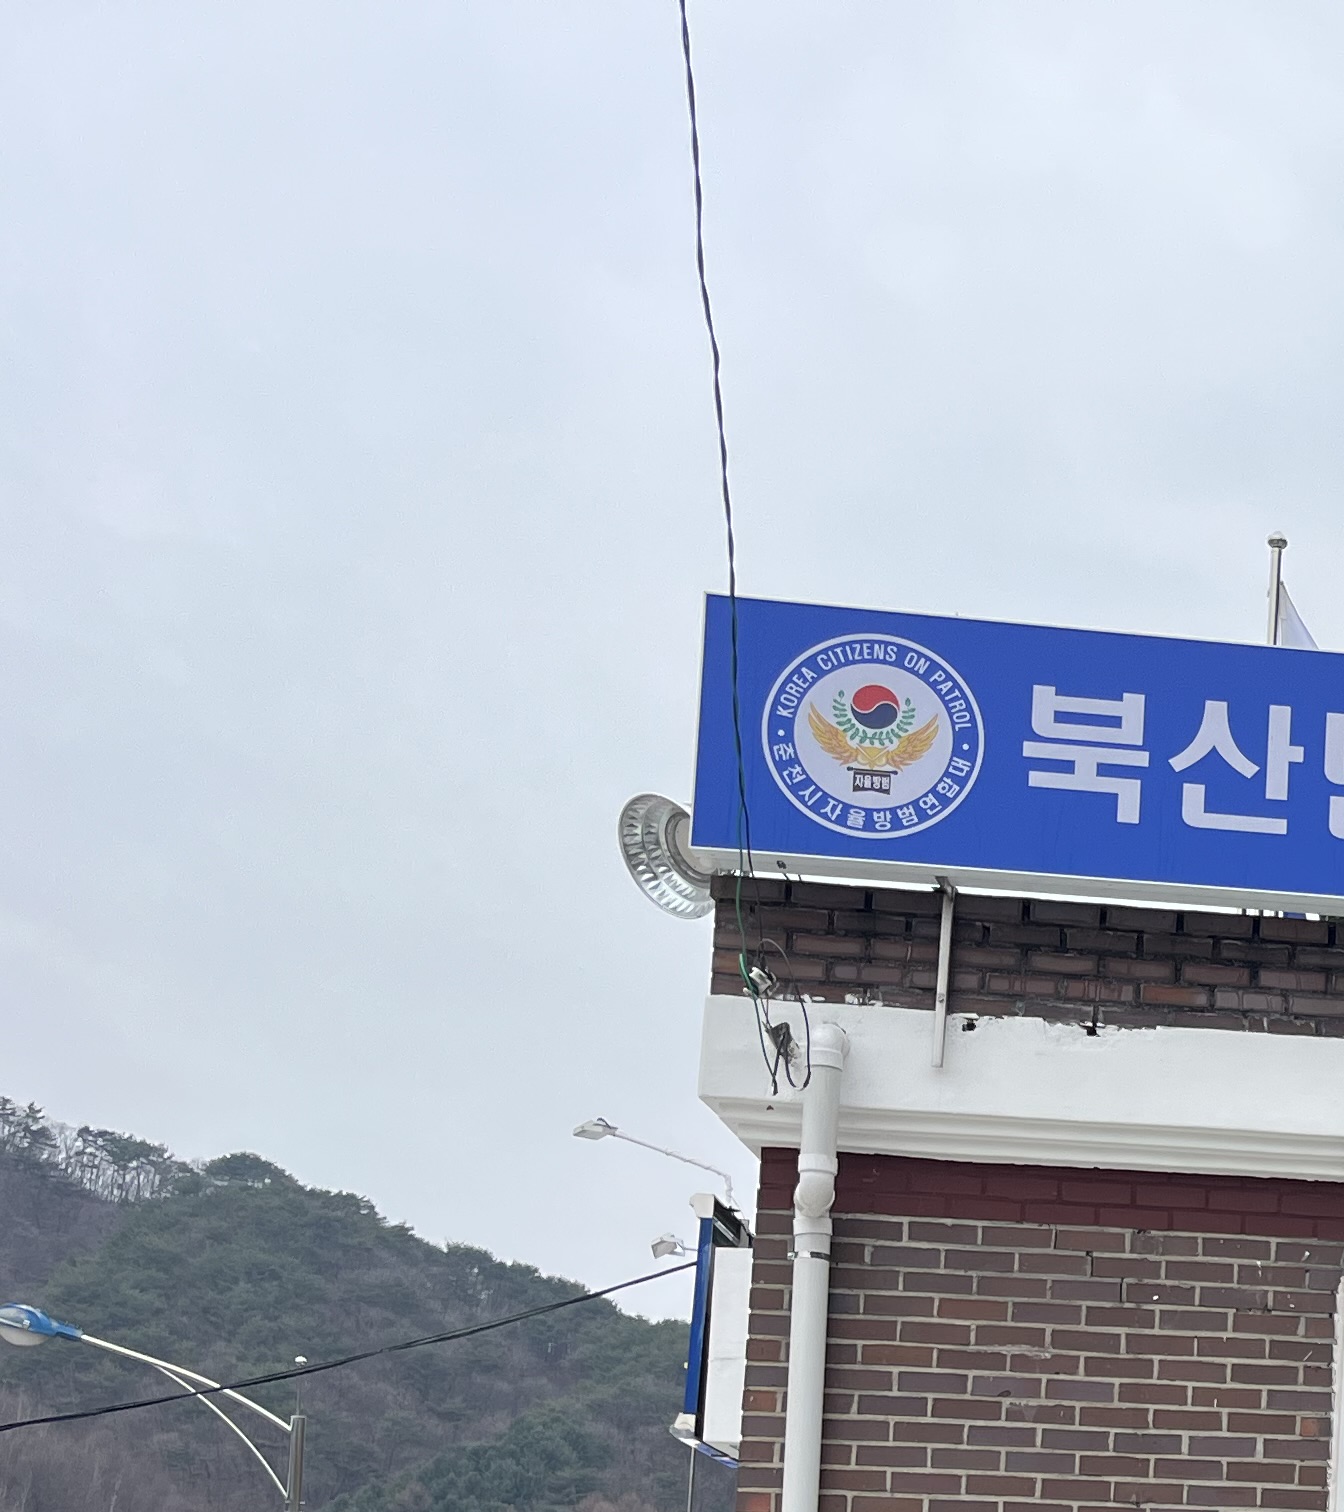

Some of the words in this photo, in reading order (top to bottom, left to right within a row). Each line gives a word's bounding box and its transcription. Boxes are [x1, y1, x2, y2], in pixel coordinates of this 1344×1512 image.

[775, 667, 818, 718] KOREA
[816, 643, 898, 670] CITIZENS
[904, 652, 932, 675] ON
[929, 669, 972, 732] PATROL
[854, 774, 890, 790] 자율방범
